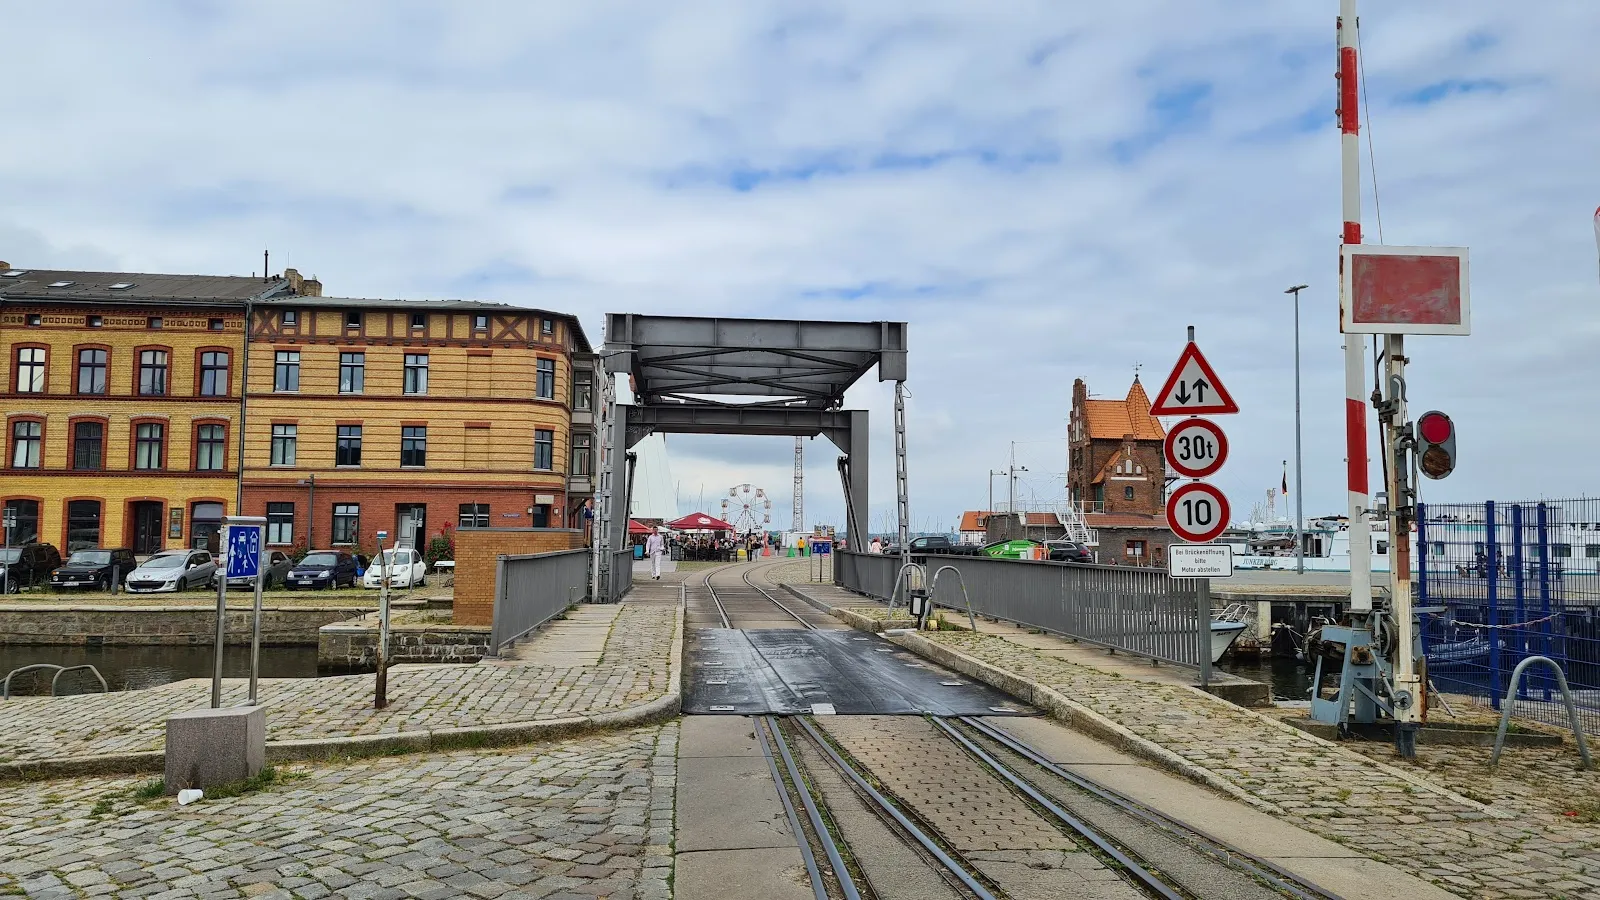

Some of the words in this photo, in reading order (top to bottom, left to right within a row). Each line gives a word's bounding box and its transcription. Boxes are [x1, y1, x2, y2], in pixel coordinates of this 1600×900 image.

[1178, 435, 1214, 461] 30t
[1182, 499, 1212, 526] 10
[1185, 548, 1225, 557] Brückenöffnung
[1242, 558, 1264, 566] JUNKER
